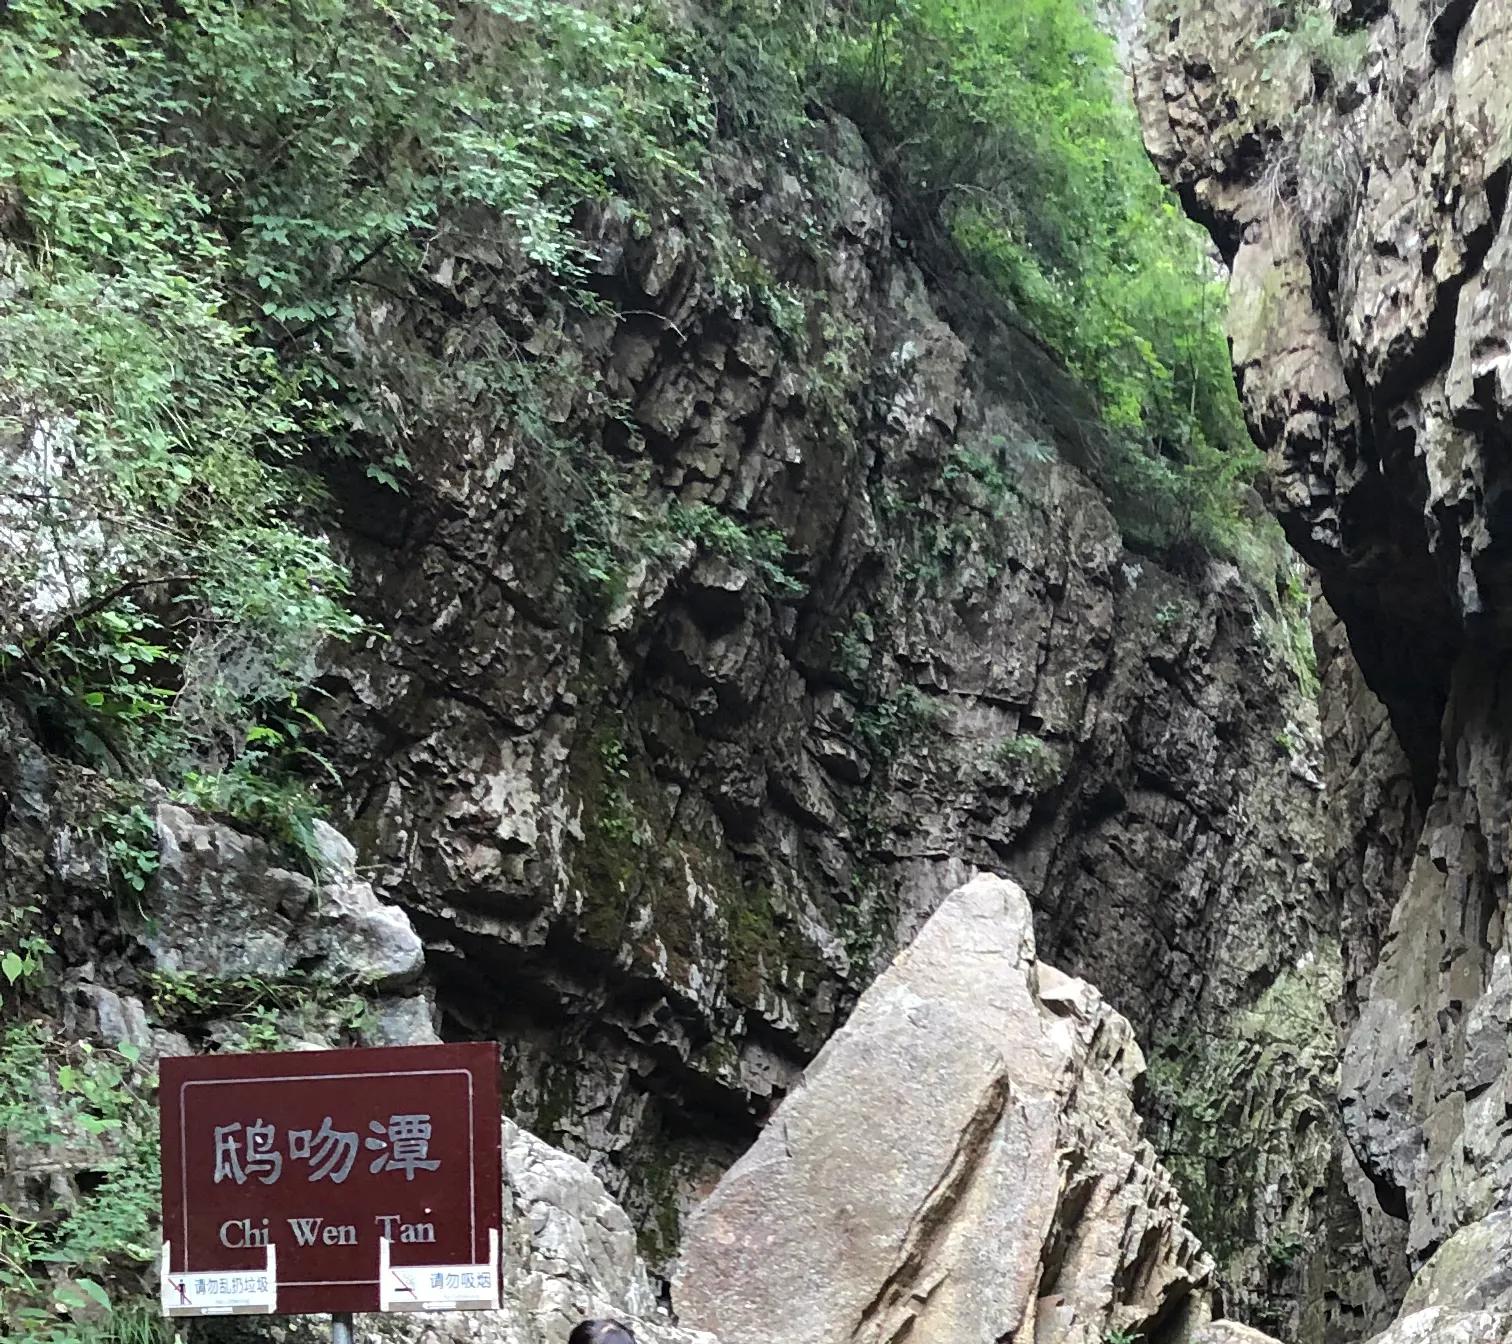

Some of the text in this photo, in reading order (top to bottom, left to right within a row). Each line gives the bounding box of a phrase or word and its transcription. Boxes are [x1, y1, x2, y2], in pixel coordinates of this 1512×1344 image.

[213, 1114, 442, 1185] 鸱吻潭
[219, 1214, 437, 1249] Chi Wen Tan
[194, 1276, 269, 1295] 请勿乱扔垃圾
[430, 1271, 492, 1289] 请勿吸烟
